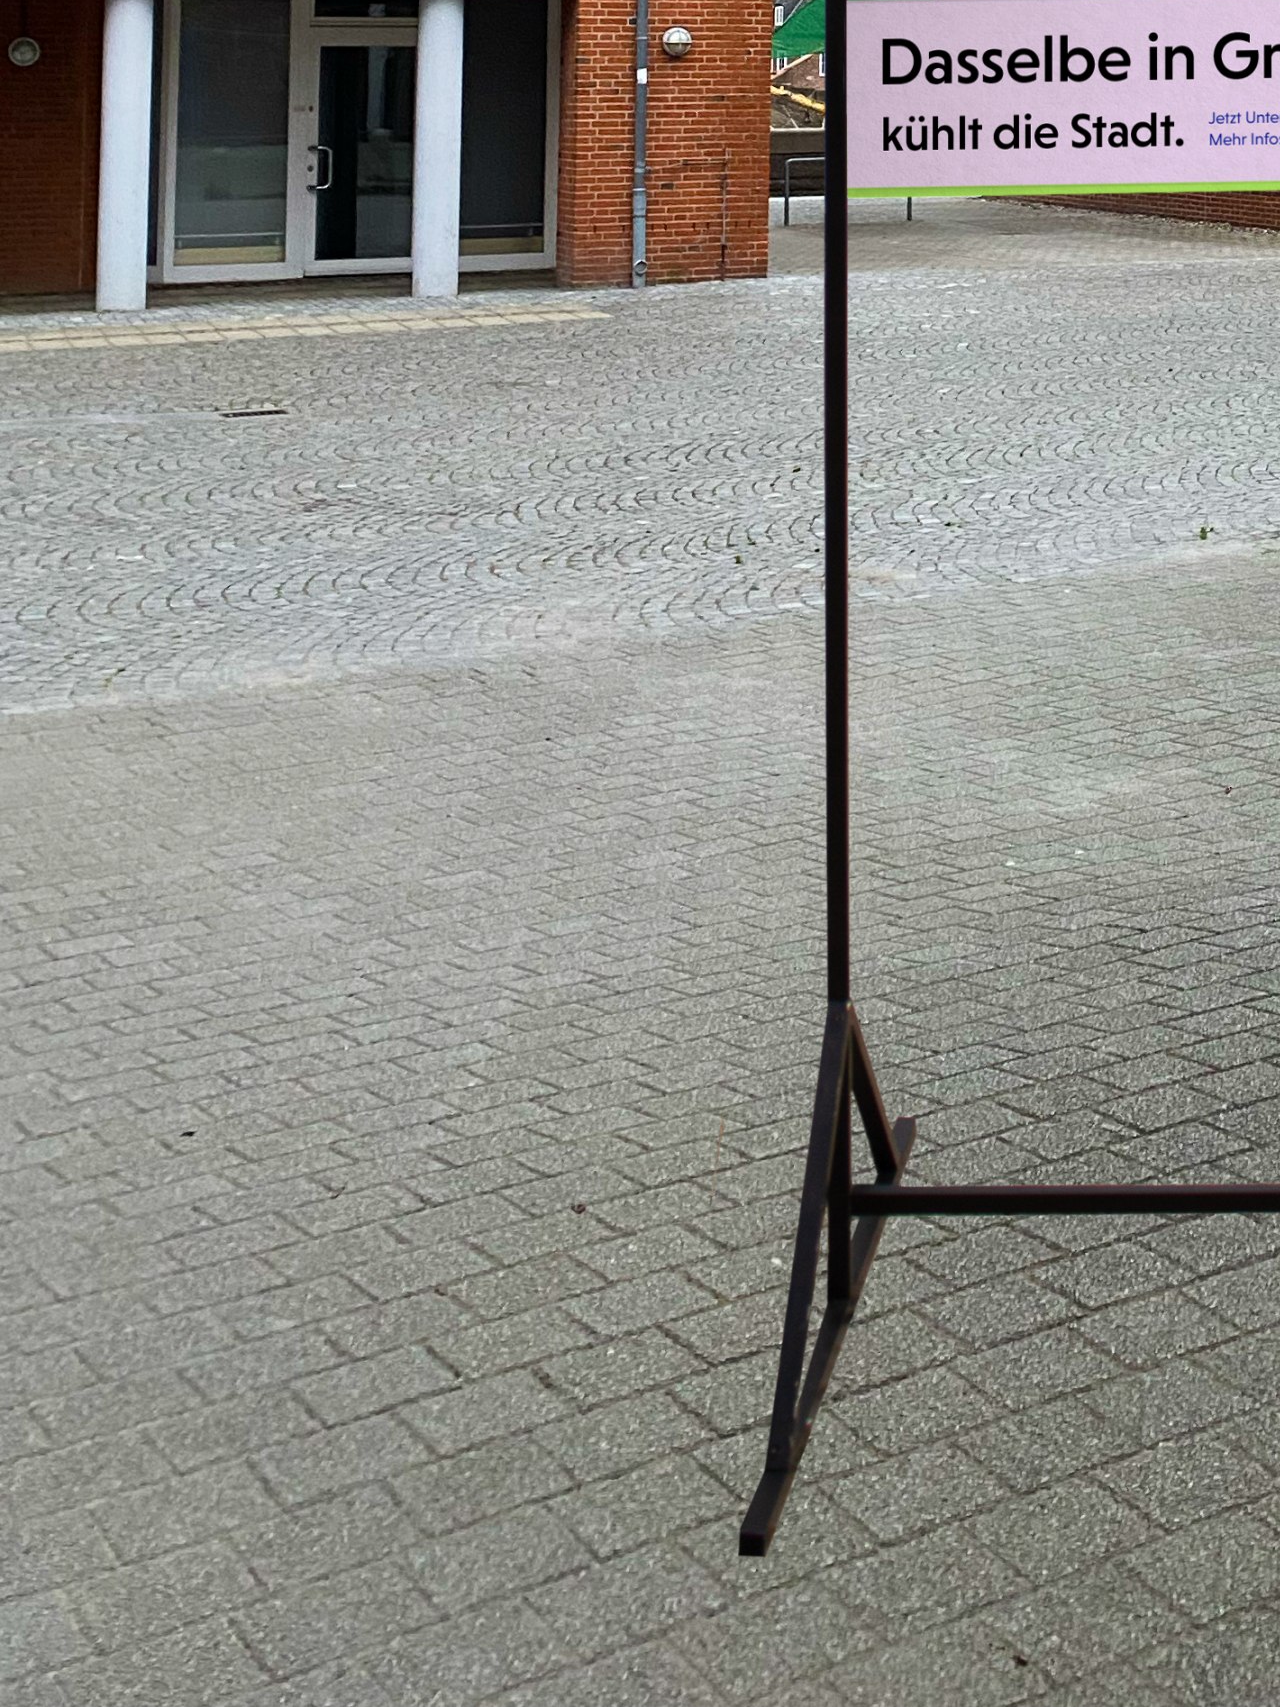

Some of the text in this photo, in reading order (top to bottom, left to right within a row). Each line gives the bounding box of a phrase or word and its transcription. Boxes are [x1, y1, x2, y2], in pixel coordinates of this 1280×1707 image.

[881, 34, 1132, 86] Dasselbe
[1148, 31, 1195, 81] in
[882, 111, 1185, 152] kühlt die Stadt.
[1208, 111, 1242, 125] Jetzt
[1208, 132, 1248, 146] Mehr
